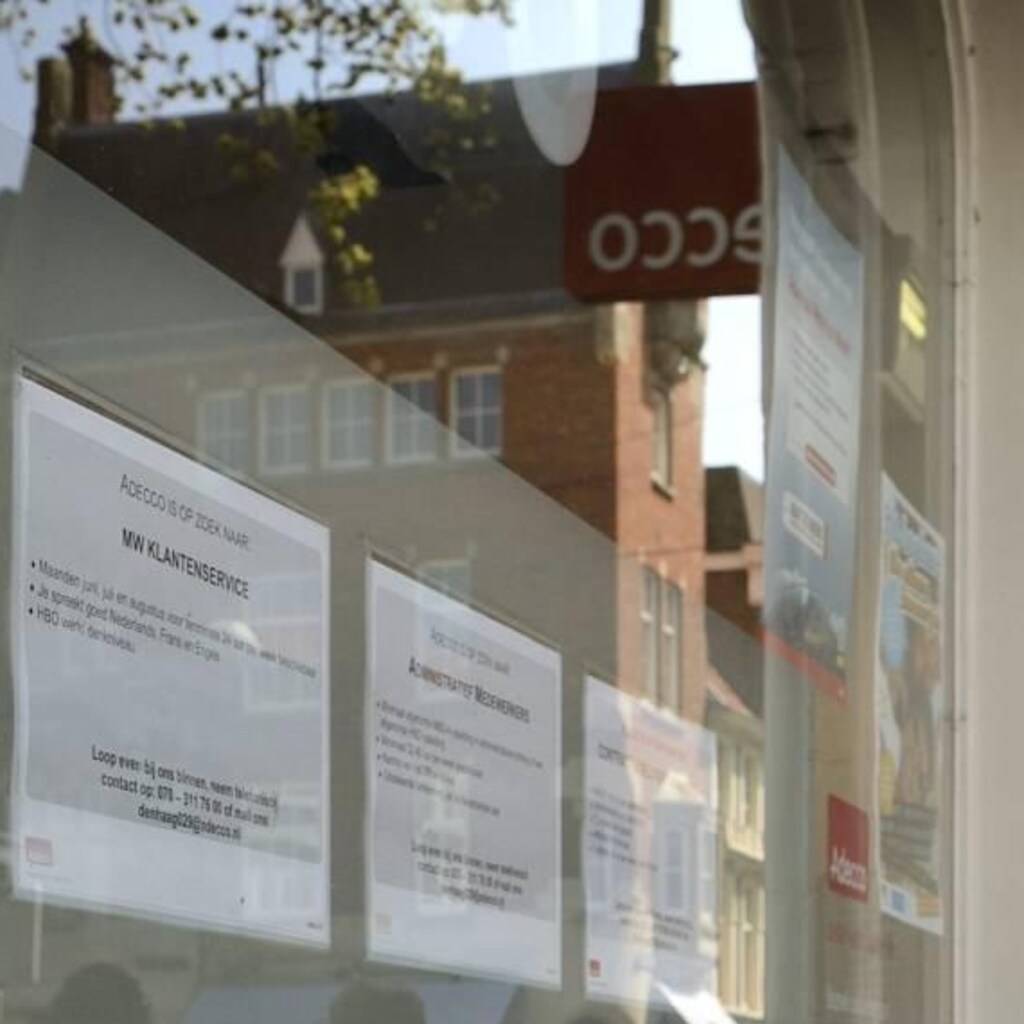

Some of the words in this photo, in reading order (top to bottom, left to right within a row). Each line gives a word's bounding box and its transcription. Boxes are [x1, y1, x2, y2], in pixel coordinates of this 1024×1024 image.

[121, 528, 146, 553] MW
[147, 539, 249, 600] KLANTENSERVICE
[37, 602, 59, 627] HBO
[91, 744, 116, 768] Loop
[118, 755, 141, 771] even
[144, 759, 156, 779] bij
[158, 766, 174, 782] ons
[101, 773, 139, 795] contact
